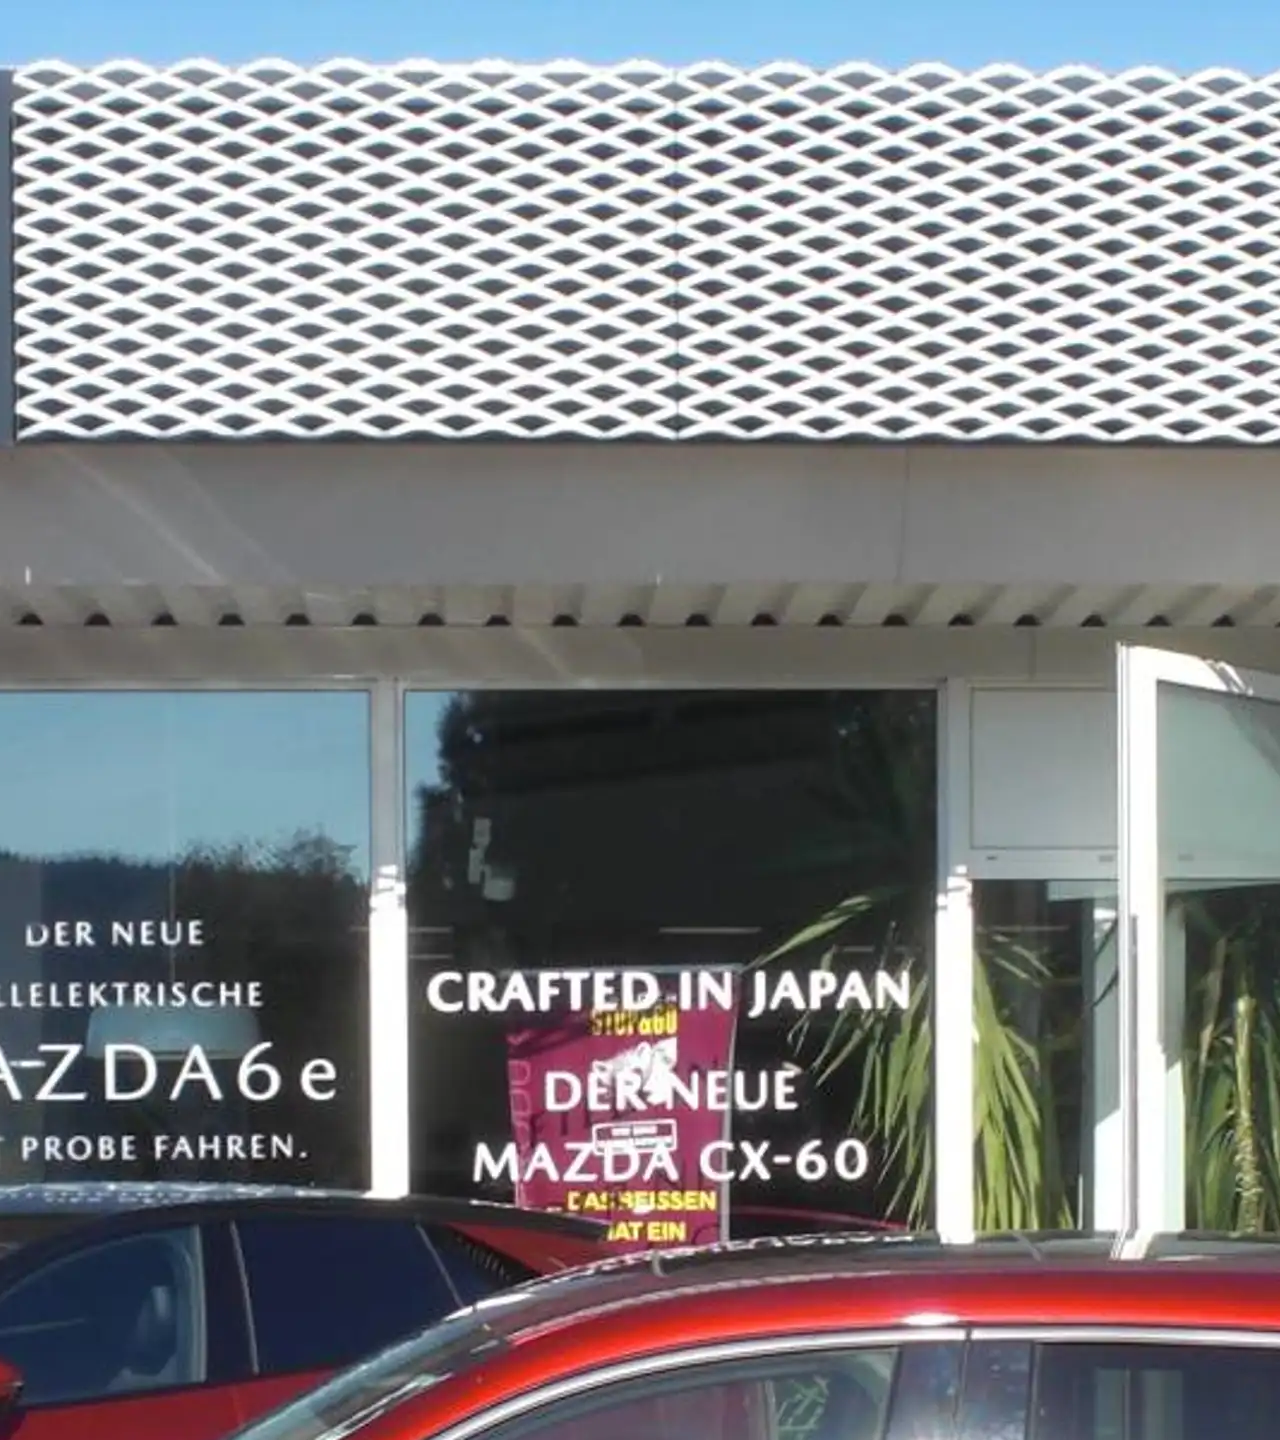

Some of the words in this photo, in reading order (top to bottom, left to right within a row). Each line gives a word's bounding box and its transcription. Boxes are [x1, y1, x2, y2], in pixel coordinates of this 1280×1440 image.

[25, 920, 95, 948] DER
[111, 919, 205, 946] NEUE
[426, 970, 661, 1011] CRAFTED
[679, 970, 733, 1011] IN
[748, 970, 911, 1018] JAPAN
[545, 1070, 648, 1112] DER
[666, 1070, 798, 1111] NEUE
[21, 1134, 136, 1162] PROBE
[154, 1133, 308, 1161] FAHREN.
[473, 1142, 679, 1183] MAZDA
[700, 1138, 869, 1182] CX-60
[647, 1221, 687, 1242] EIN
